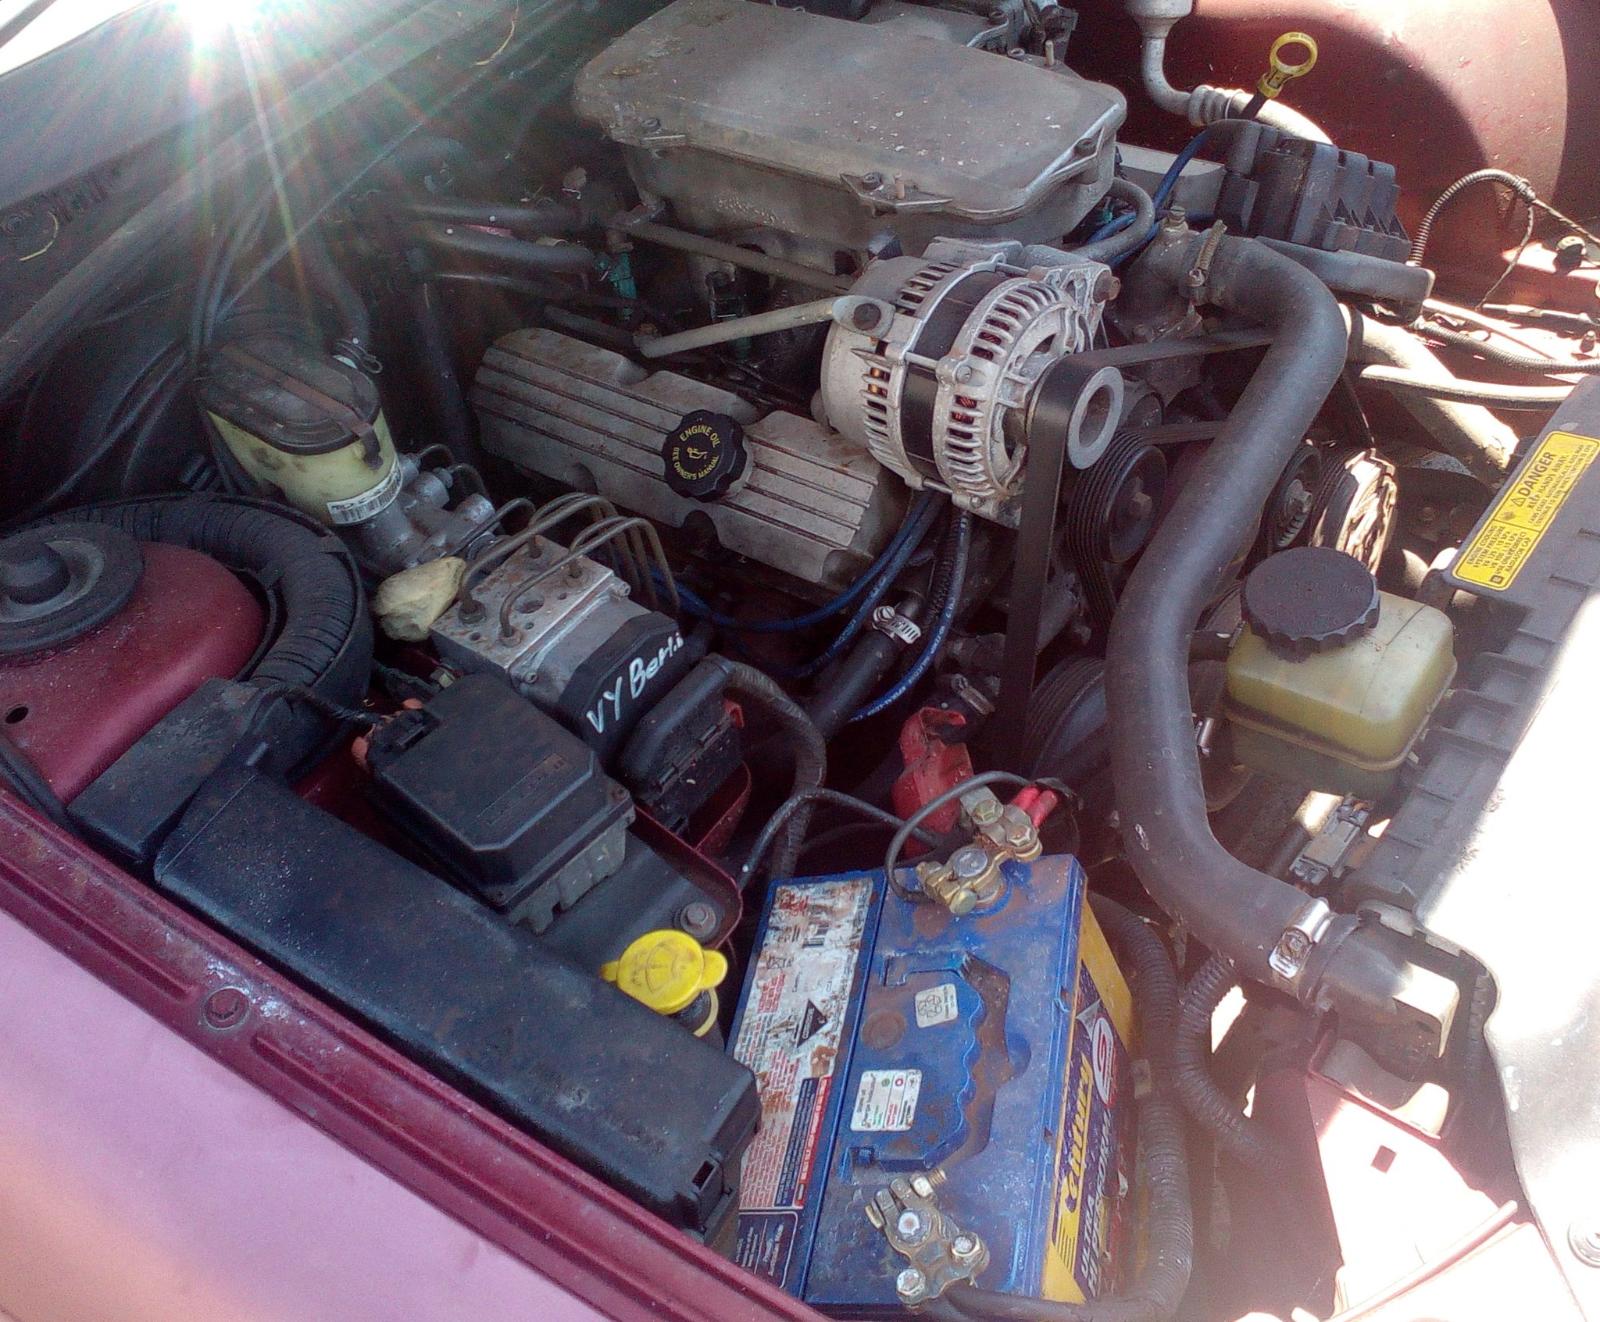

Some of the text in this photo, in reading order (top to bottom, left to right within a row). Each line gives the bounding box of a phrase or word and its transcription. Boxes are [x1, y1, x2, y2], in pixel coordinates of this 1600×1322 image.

[680, 425, 720, 448] ENGINE OIL
[1518, 451, 1556, 497] DANGER
[1536, 472, 1556, 493] HANDS
[1478, 524, 1497, 546] COOLING
[586, 677, 623, 733] VY
[1060, 1053, 1094, 1216] Century
[1081, 1195, 1095, 1279] ULTRA
